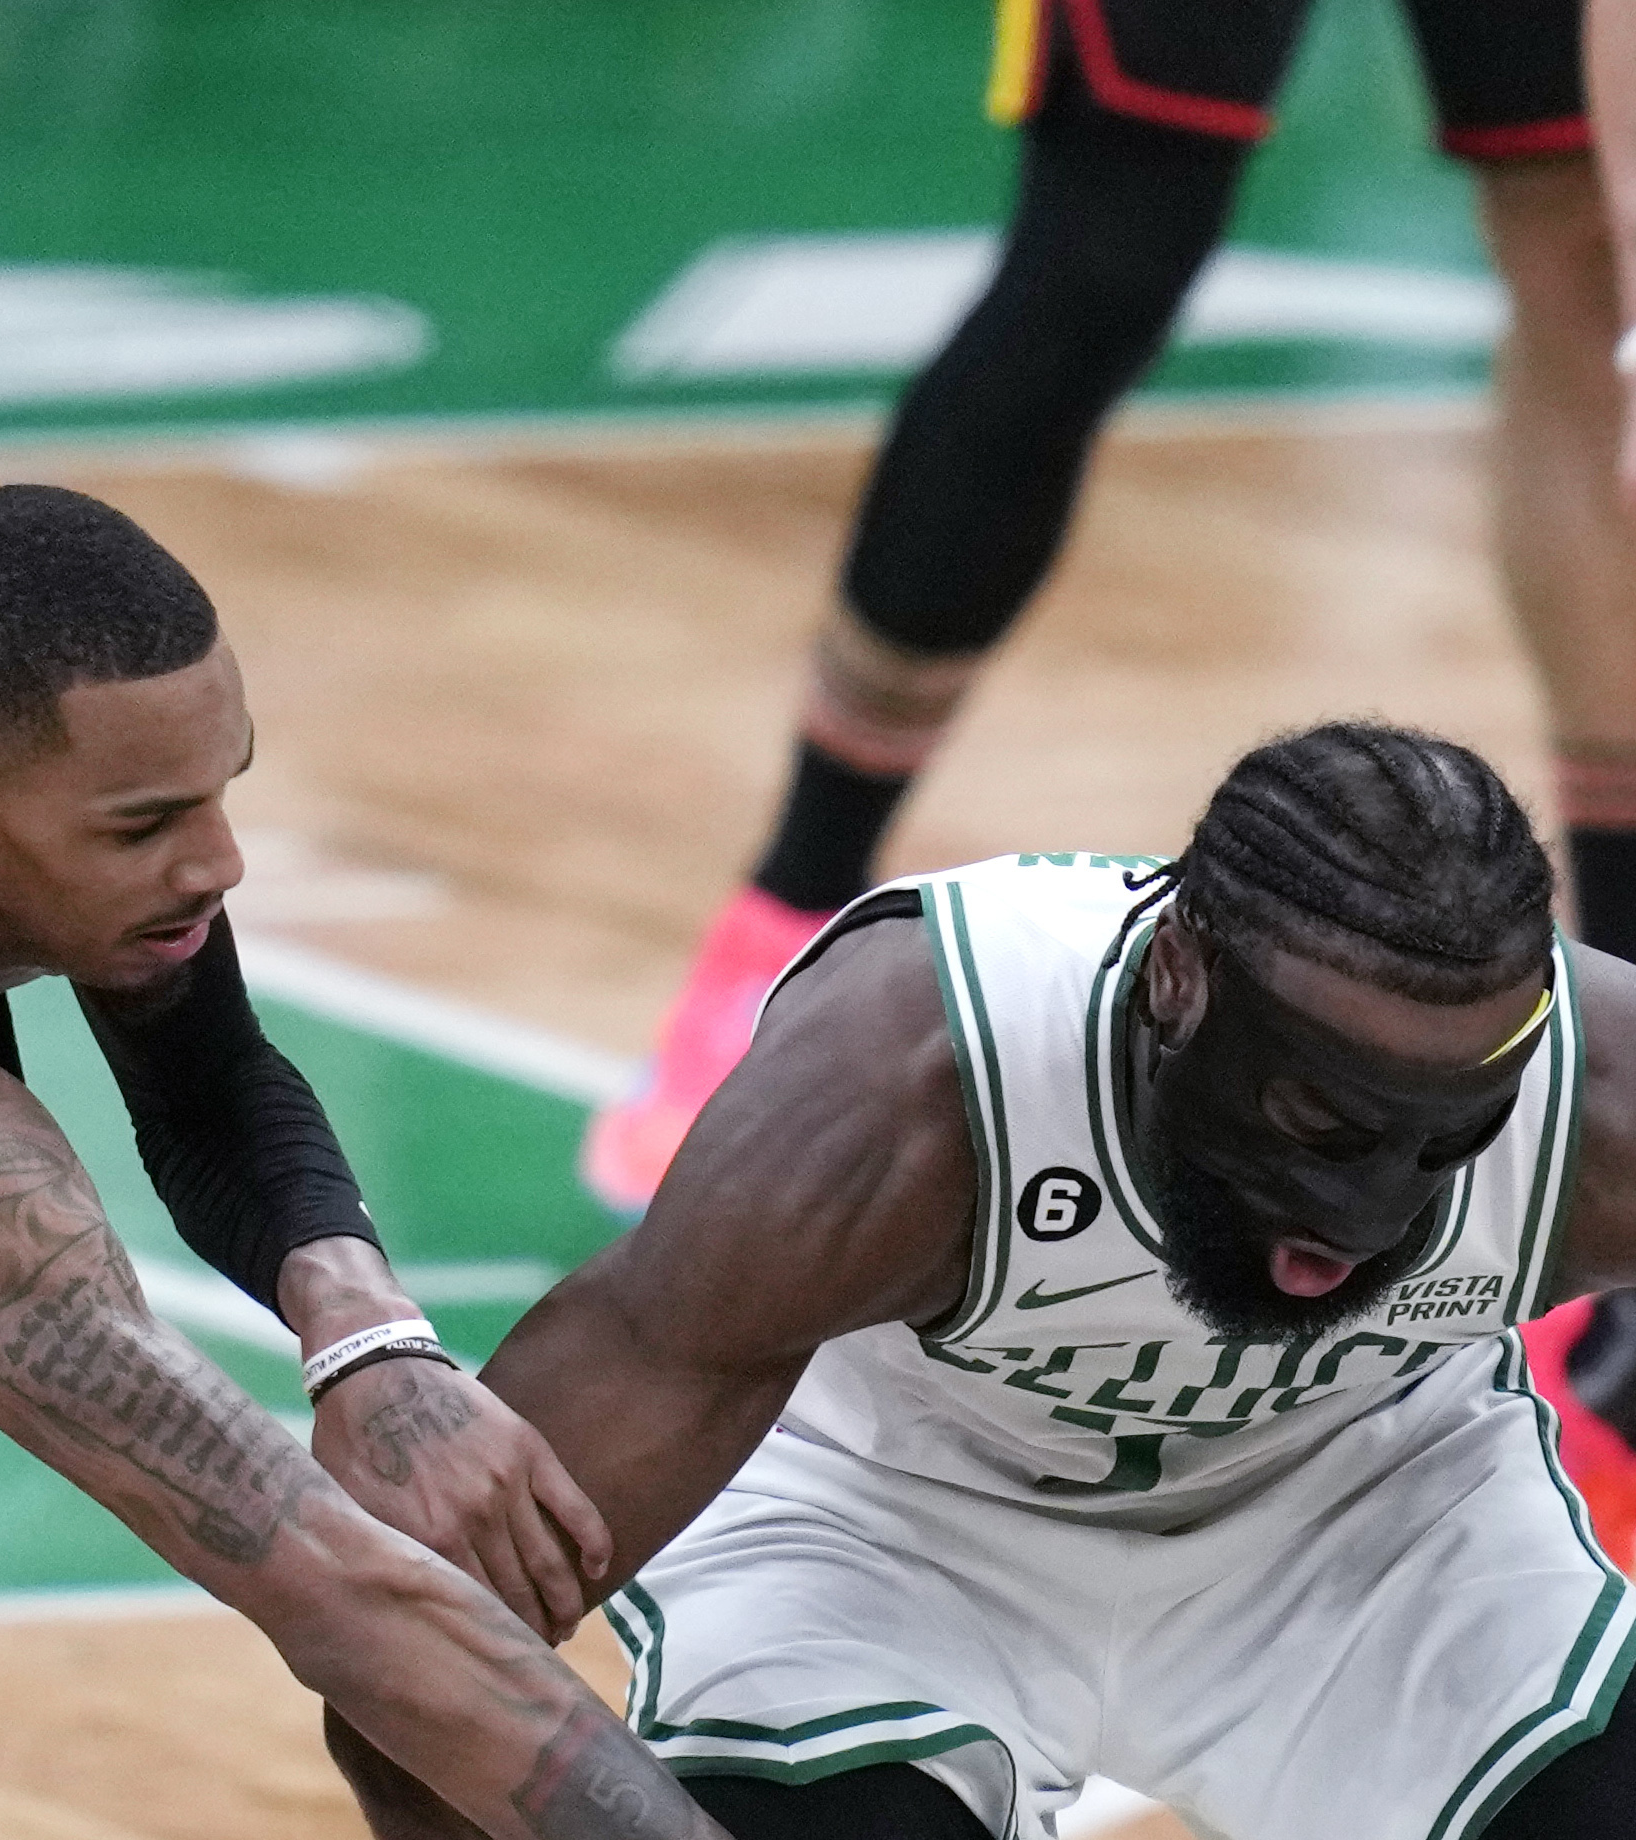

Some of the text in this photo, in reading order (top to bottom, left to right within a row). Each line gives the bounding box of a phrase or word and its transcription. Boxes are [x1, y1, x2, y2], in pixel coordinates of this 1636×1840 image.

[1033, 1178, 1082, 1233] 6
[1397, 1275, 1505, 1301] VISTA
[1386, 1299, 1498, 1327] PRINT
